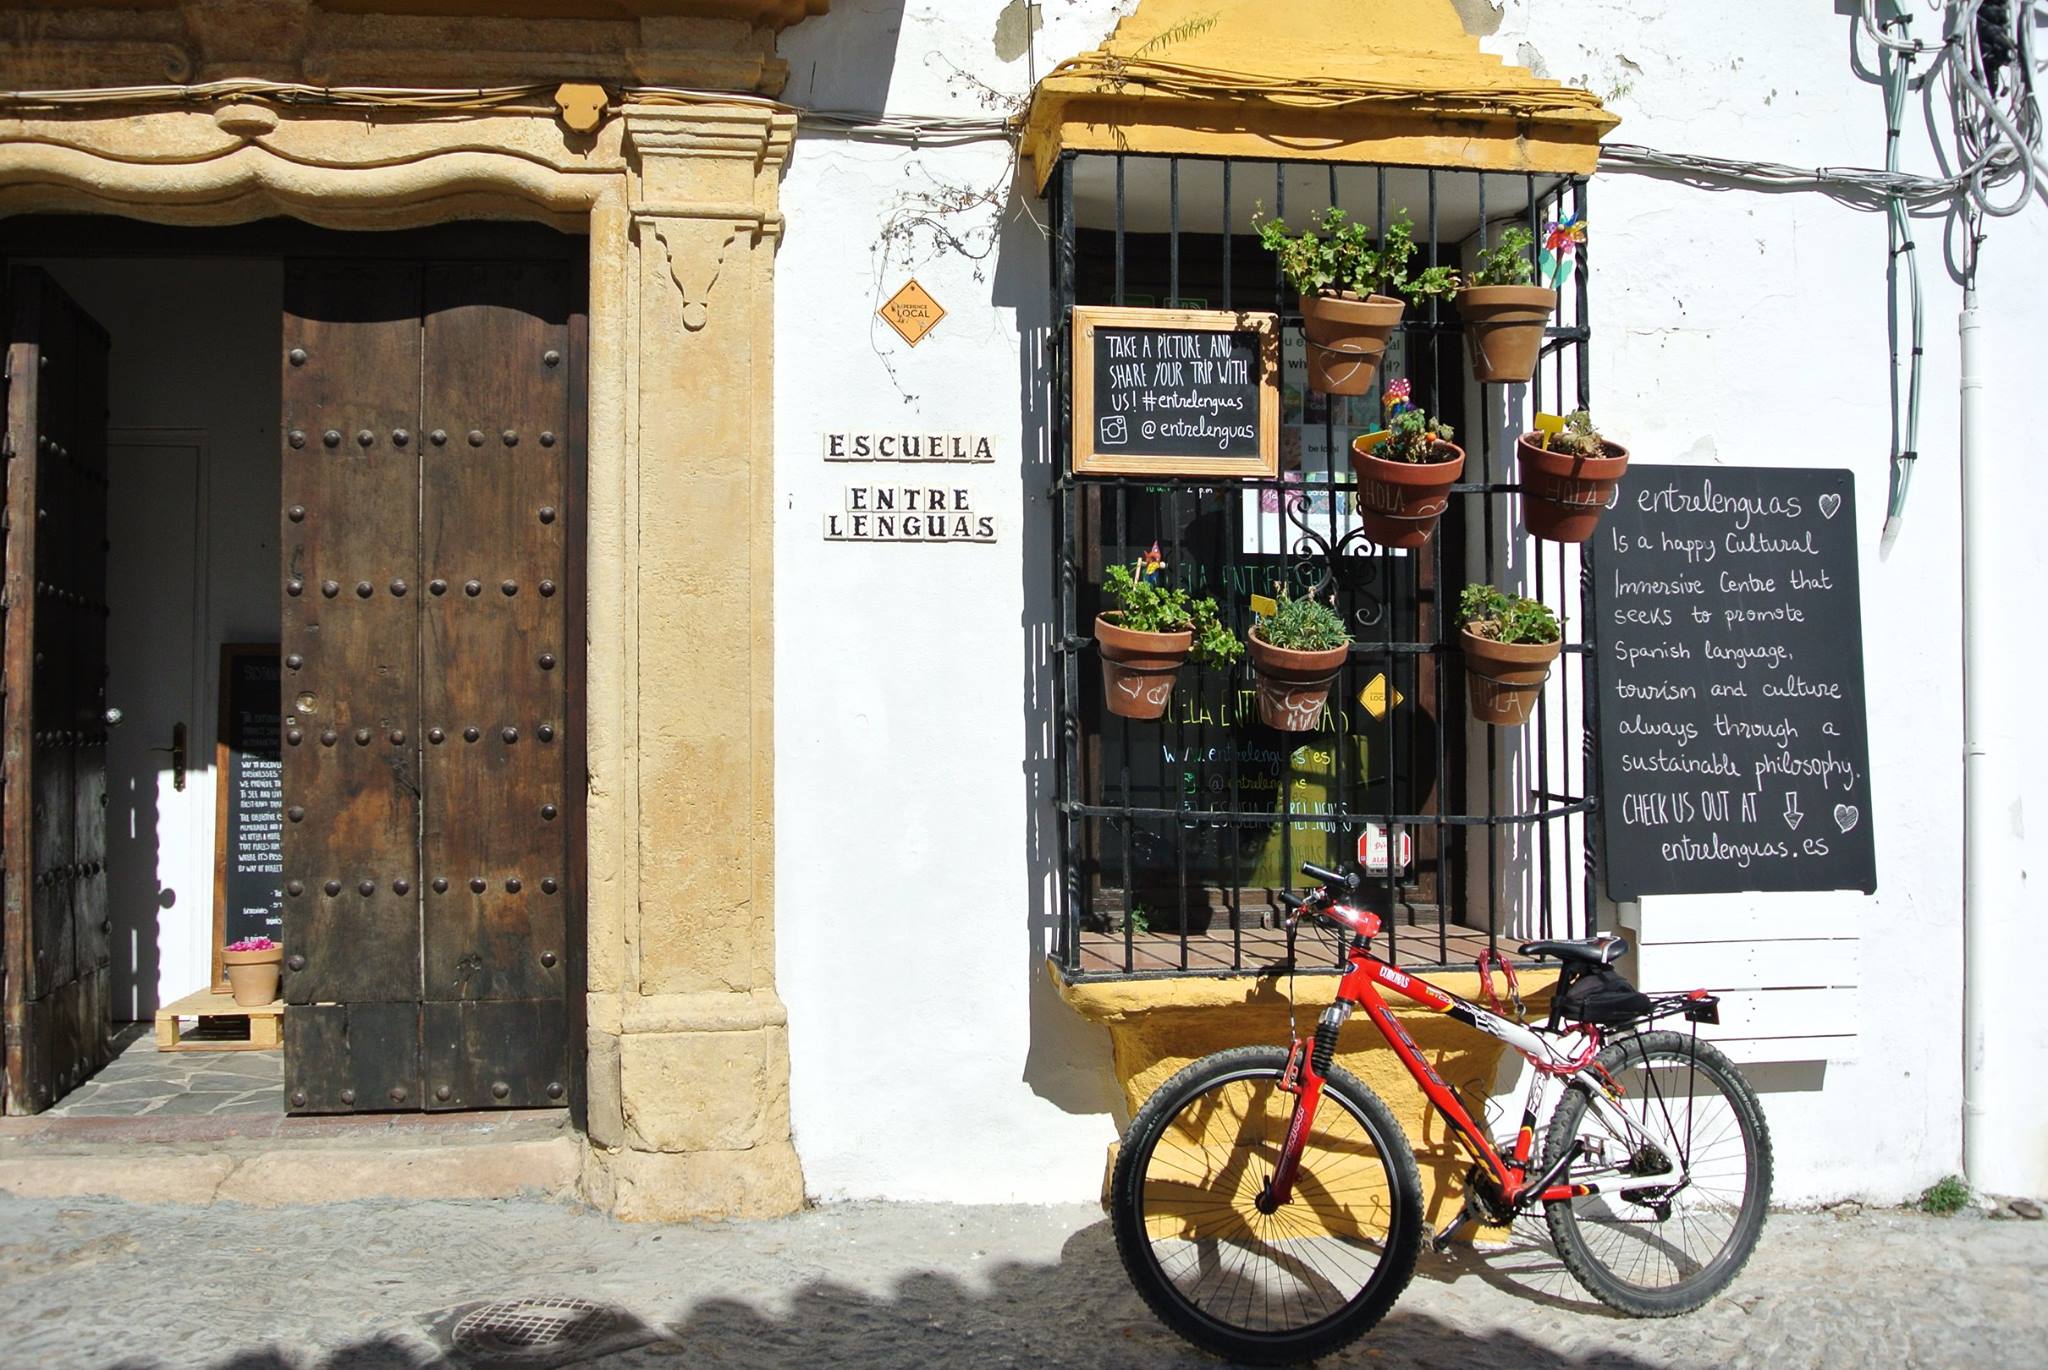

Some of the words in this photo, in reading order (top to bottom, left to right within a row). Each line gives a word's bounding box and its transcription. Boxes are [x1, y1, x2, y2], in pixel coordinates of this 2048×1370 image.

[897, 309, 930, 318] LOCAL
[1105, 336, 1137, 359] TAKE
[1142, 336, 1151, 358] A
[1157, 333, 1201, 359] PICTURE
[1210, 335, 1232, 358] AND
[1109, 362, 1147, 389] SHARE
[1153, 361, 1184, 387] YOUR
[1190, 358, 1213, 385] TRIP
[1218, 358, 1248, 385] WITH
[1111, 392, 1136, 413] US!
[1142, 389, 1244, 416] #entrelenguas
[828, 434, 993, 458] ESCUELA
[851, 487, 970, 510] ENTRE
[1638, 479, 1801, 529] entrelenguas
[828, 515, 994, 537] LENGUAS
[1613, 527, 1629, 553] Is
[1638, 536, 1653, 549] a
[1662, 531, 1716, 563] happy
[1726, 531, 1819, 554] Cultural
[1615, 569, 1704, 598] Immersive
[1720, 571, 1776, 593] Centre
[1790, 569, 1833, 590] that
[1691, 605, 1712, 623] to
[1724, 603, 1805, 631] promote
[1615, 640, 1690, 668] Spanish
[1616, 679, 1696, 700] tourism
[1711, 681, 1748, 698] and
[1763, 675, 1842, 699] culture
[1619, 714, 1698, 747] always
[1713, 714, 1799, 748] through
[1822, 722, 1840, 736] a
[1622, 749, 1741, 777] sustainable
[1756, 750, 1860, 791] philosophy.
[1623, 792, 1669, 826] CHECK
[1672, 791, 1695, 823] US
[1701, 791, 1730, 822] OUT
[1742, 792, 1757, 823] AT
[1662, 832, 1829, 868] entrelenguas.es
